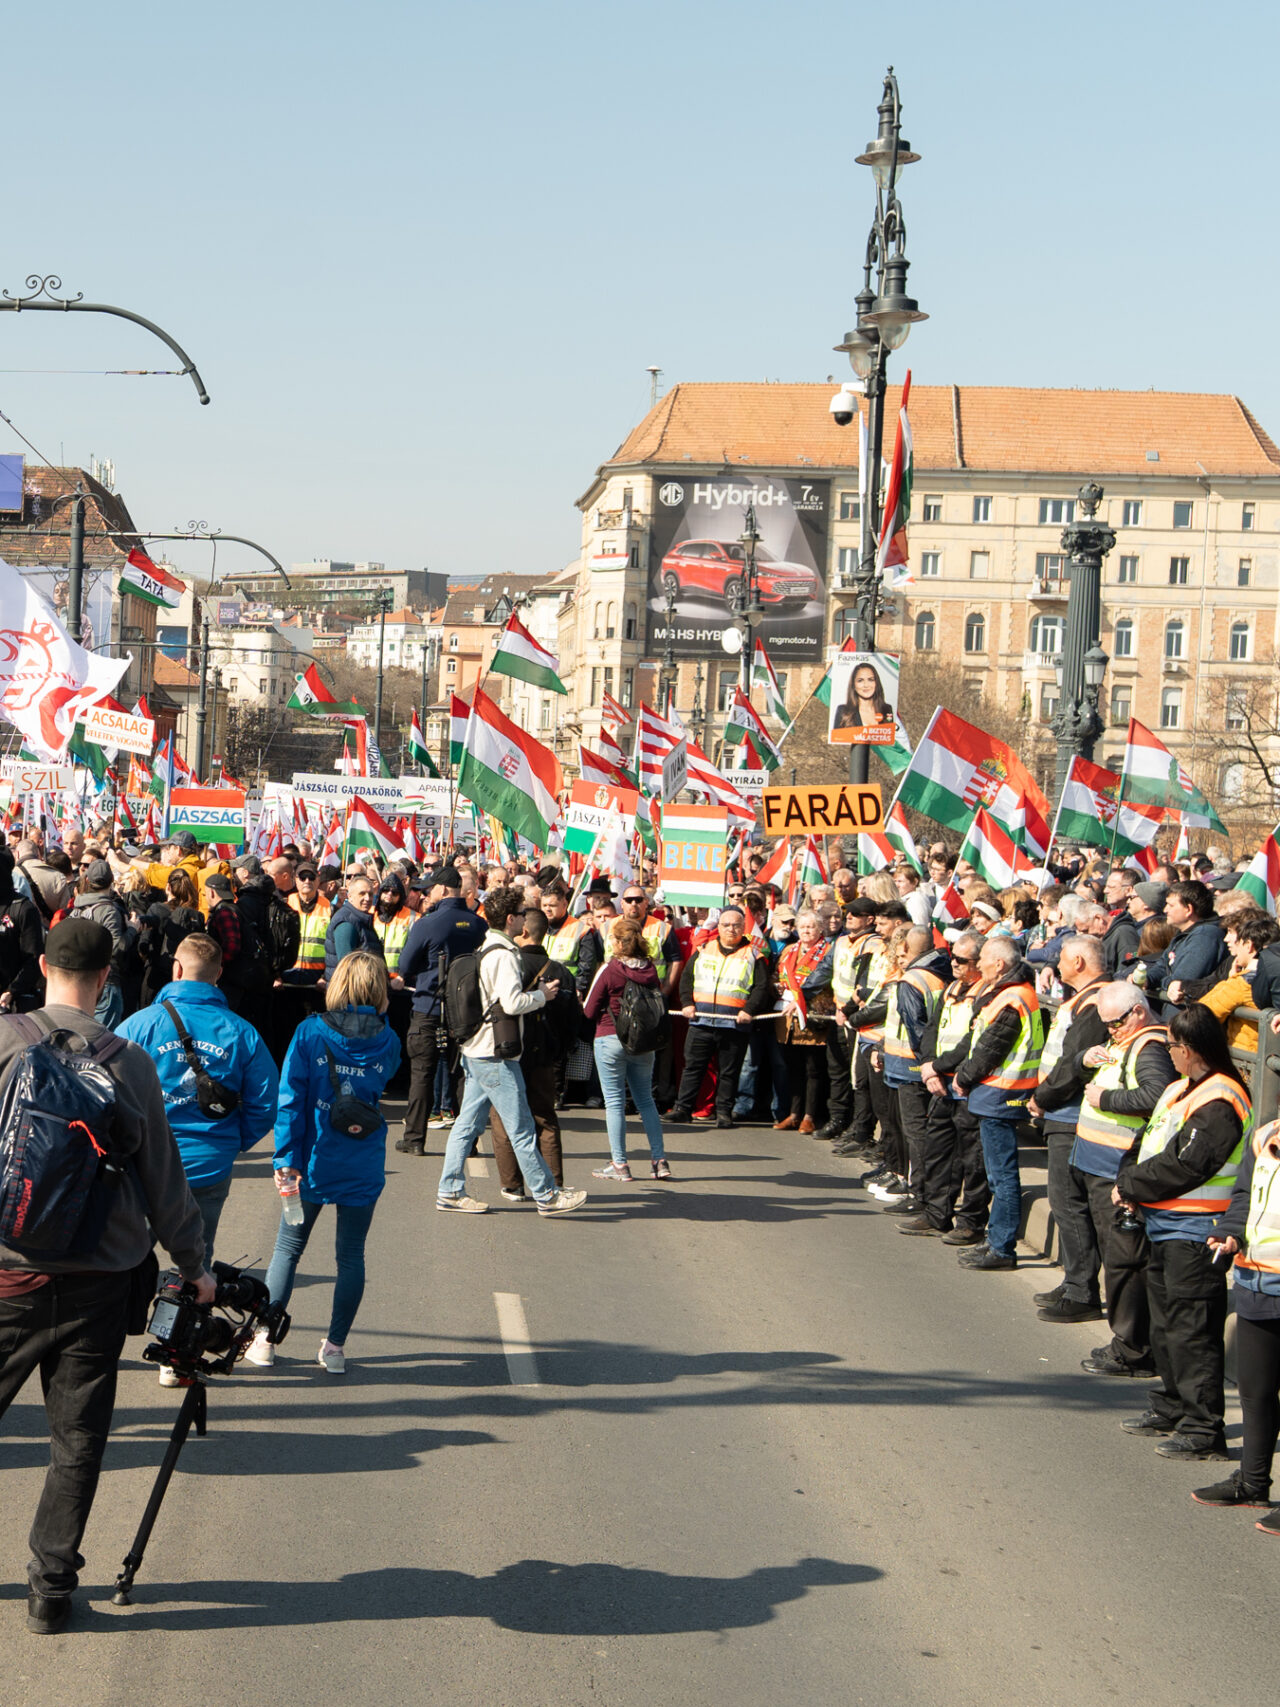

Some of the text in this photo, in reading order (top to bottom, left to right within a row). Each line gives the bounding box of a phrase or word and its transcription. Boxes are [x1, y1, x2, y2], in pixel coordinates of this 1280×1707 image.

[693, 483, 788, 510] Hybrid+
[801, 485, 813, 501] 7
[140, 573, 165, 600] TATA
[677, 628, 695, 640] HS
[768, 636, 817, 646] mgmotor.hu
[91, 711, 149, 735] ACSALAG
[21, 770, 68, 792] SZIL
[294, 781, 404, 798] JÁSZSÁGI GAZDAKÖRÖK
[171, 807, 243, 825] JÁSZSÁG
[764, 786, 881, 828] FARÁD
[665, 842, 723, 873] BÉKE
[335, 1064, 366, 1078] BRFK
